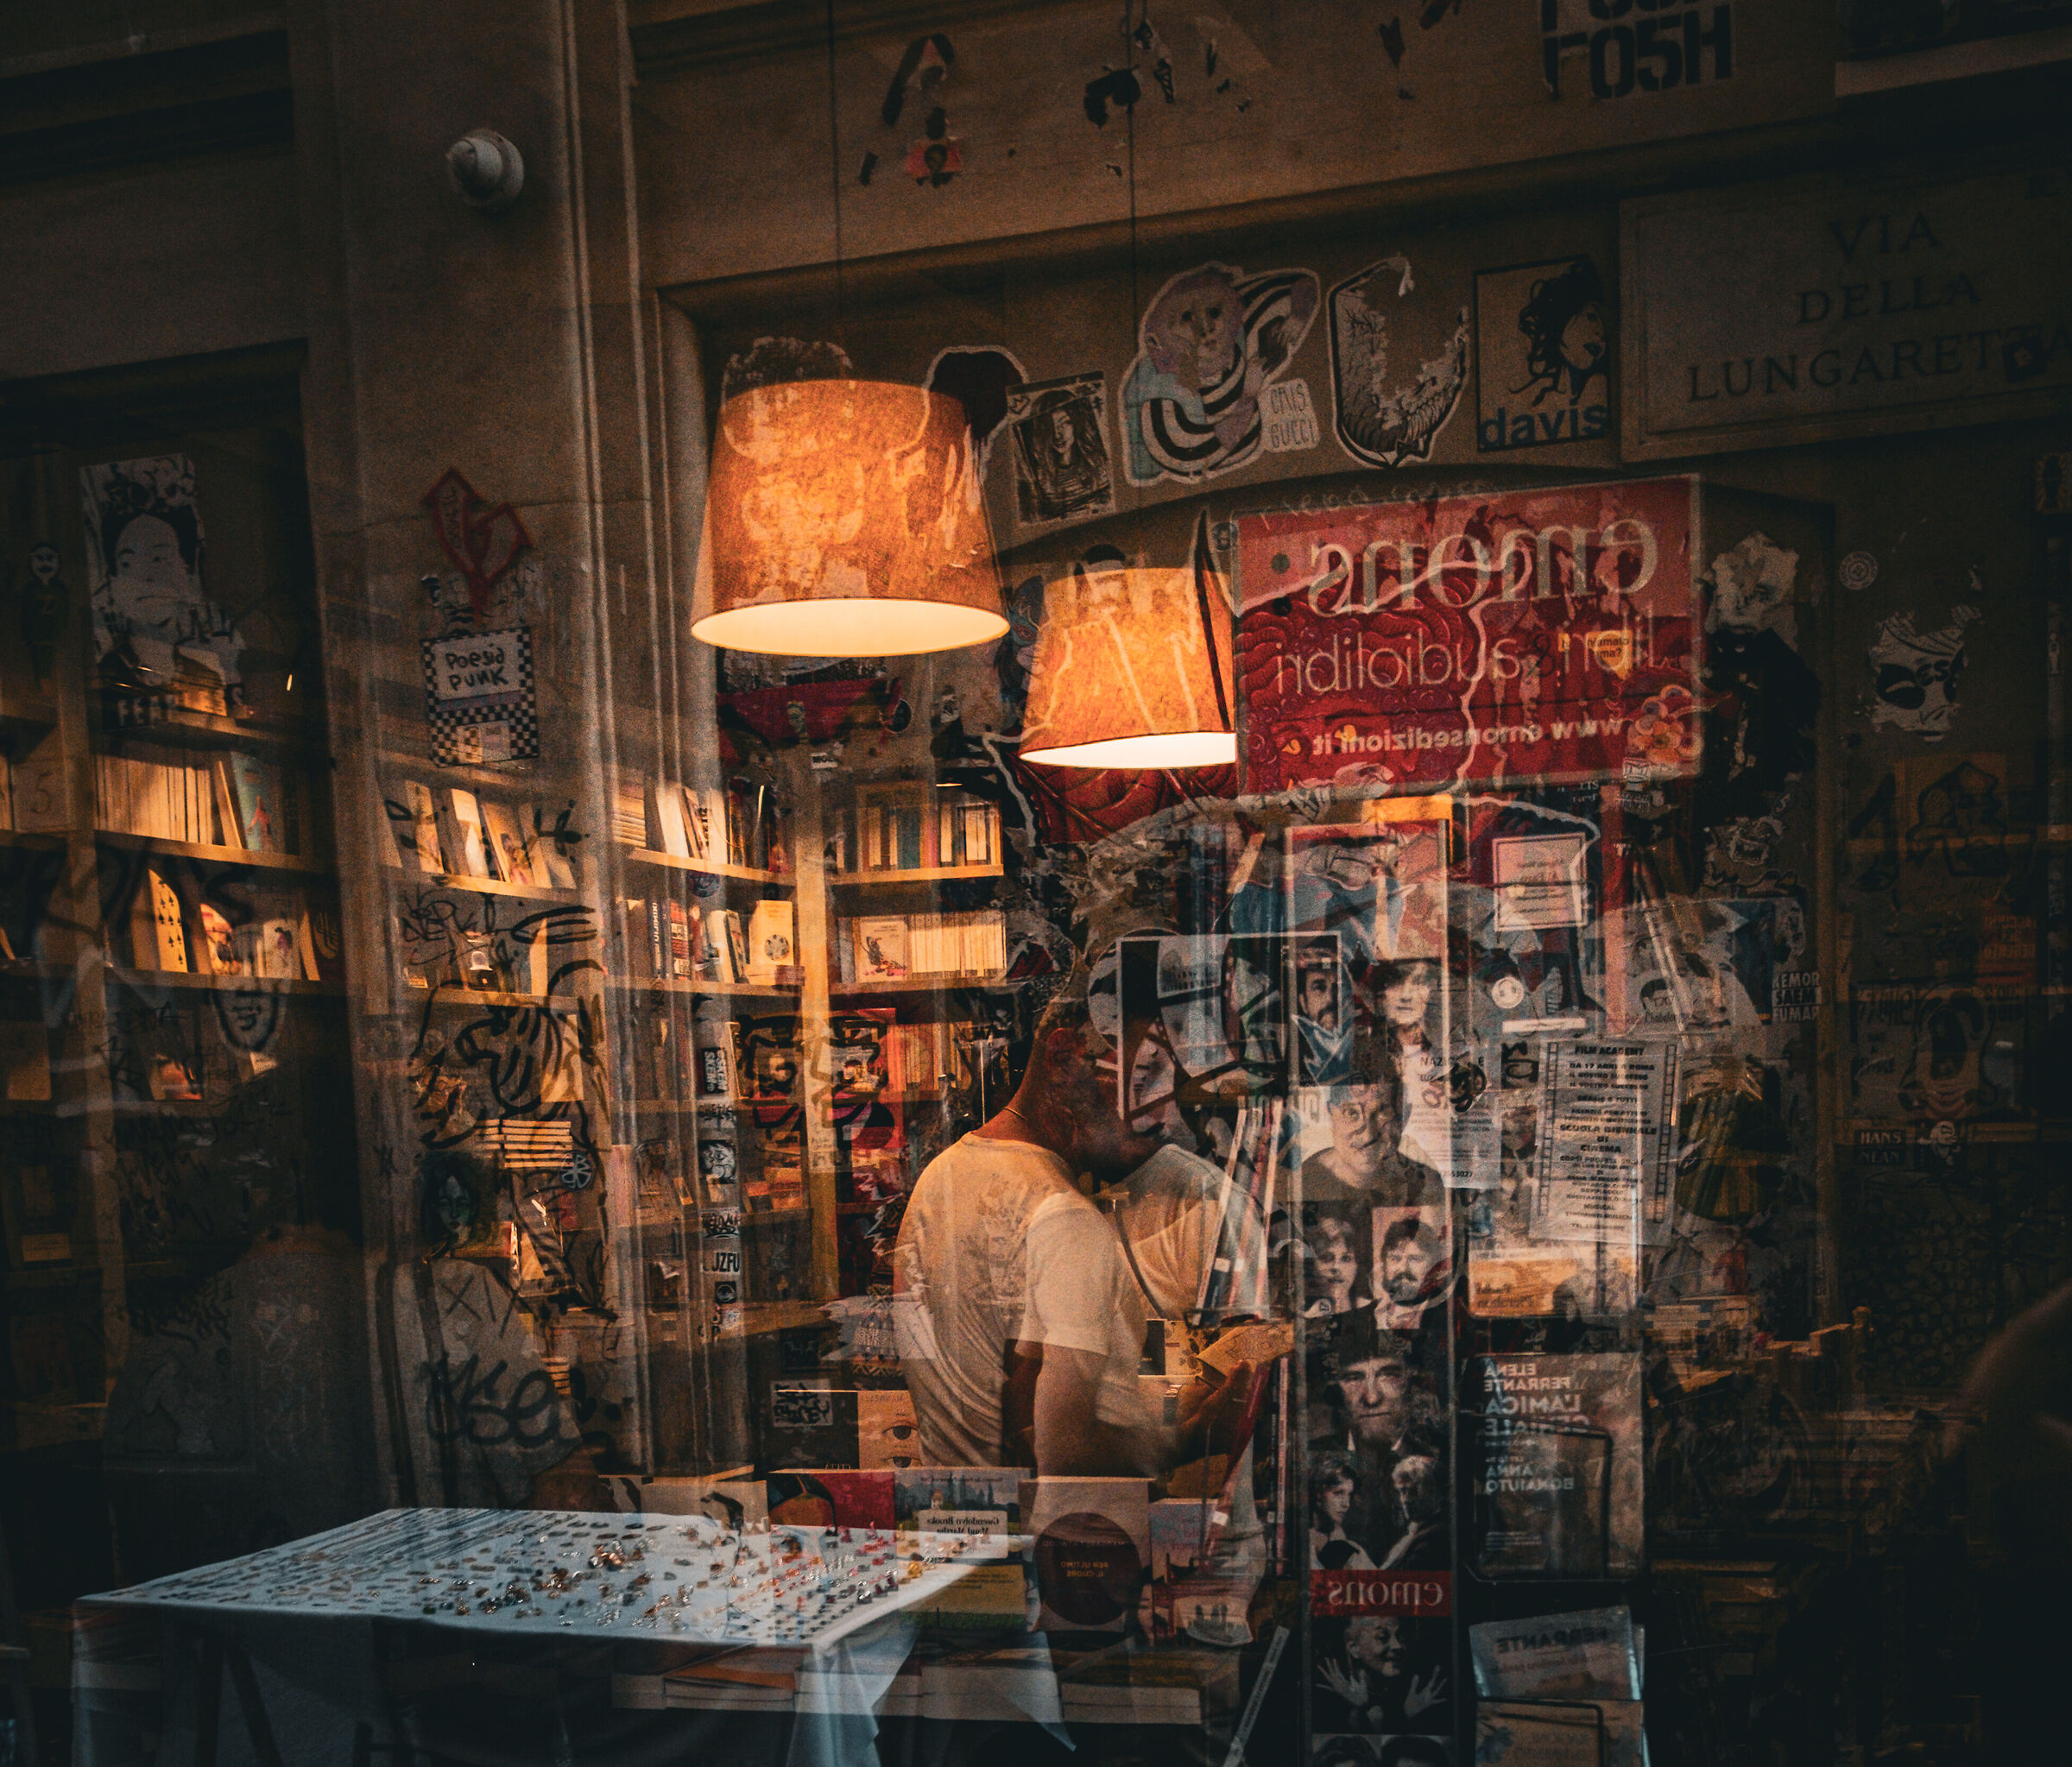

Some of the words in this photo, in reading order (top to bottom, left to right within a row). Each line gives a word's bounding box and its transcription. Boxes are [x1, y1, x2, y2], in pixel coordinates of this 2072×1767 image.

[1827, 211, 1943, 263] VIA
[1797, 270, 1982, 325] DELLA
[1477, 403, 1608, 447] davis
[448, 666, 509, 691] PUNK
[1860, 1132, 1902, 1145] HANS
